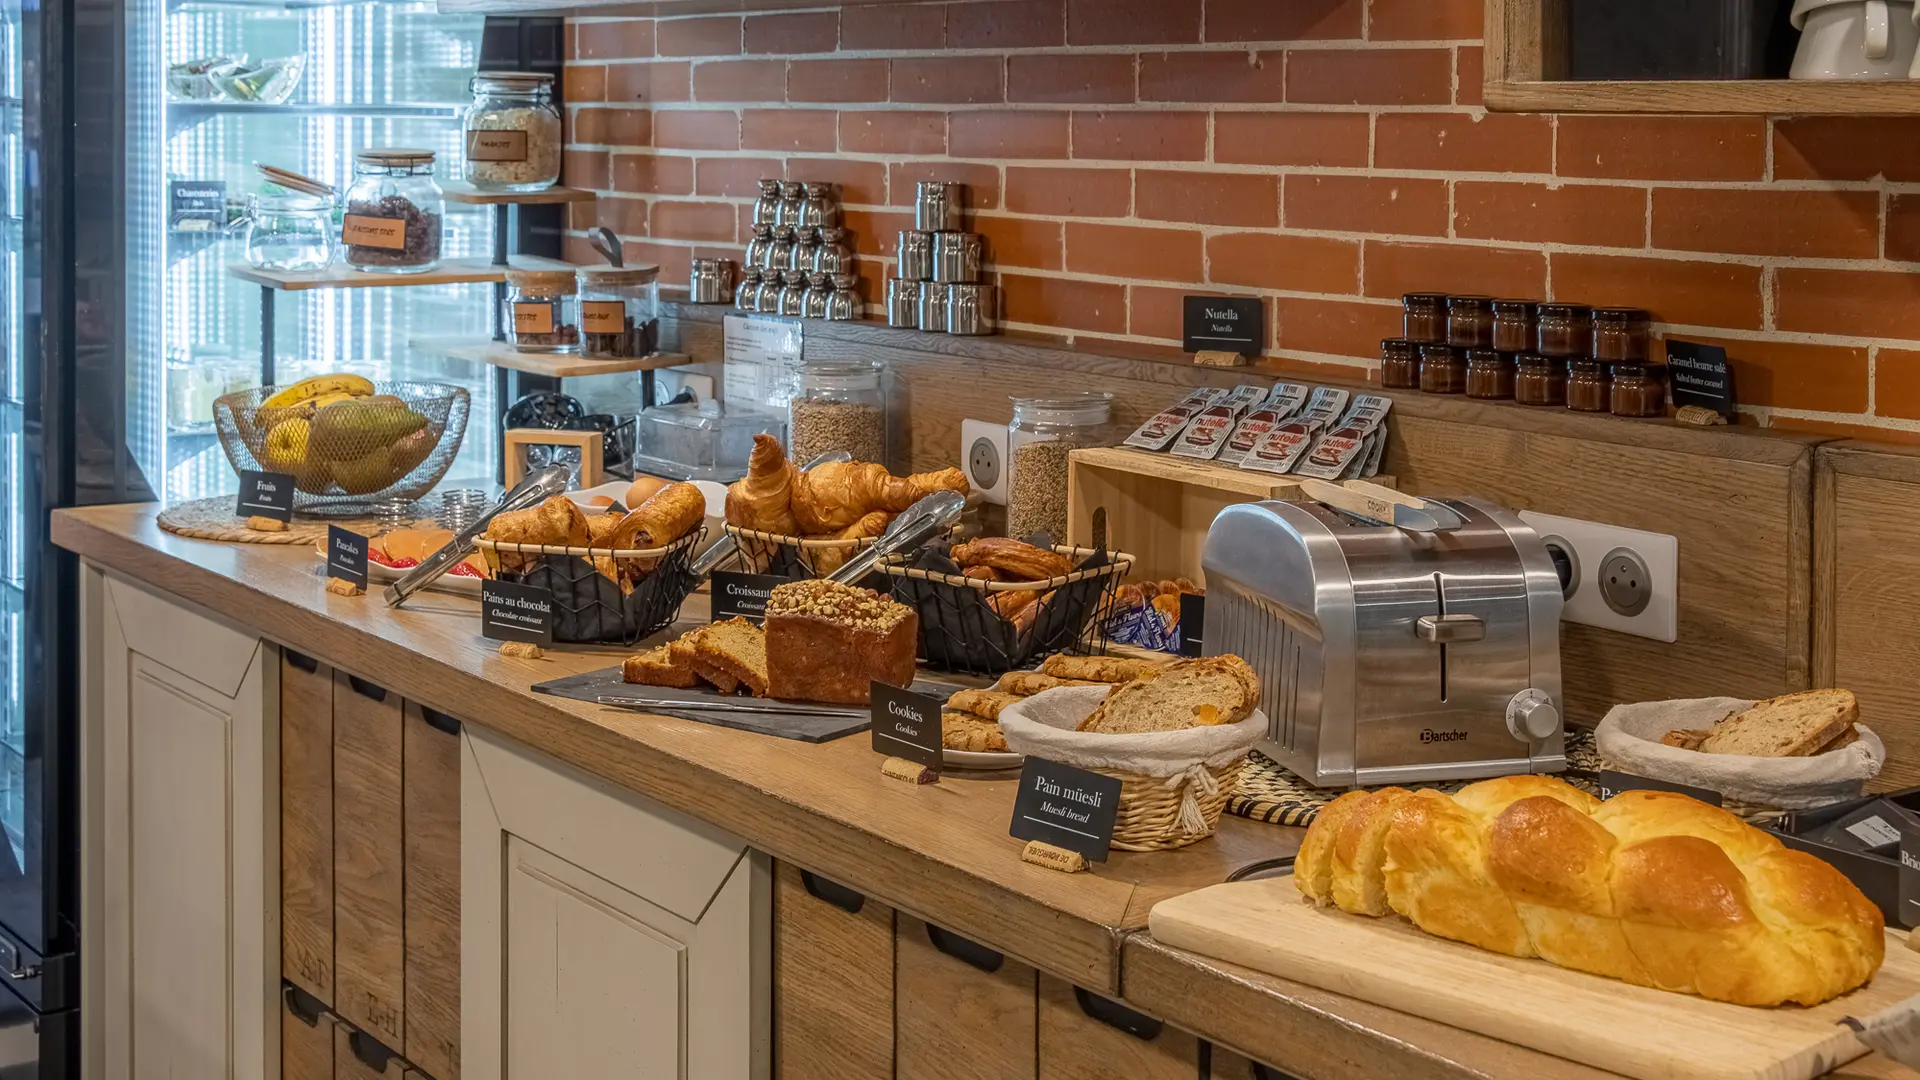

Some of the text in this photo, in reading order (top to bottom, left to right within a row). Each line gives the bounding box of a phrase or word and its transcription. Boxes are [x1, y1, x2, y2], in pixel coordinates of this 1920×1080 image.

[1205, 308, 1238, 320] Nutella
[1211, 324, 1233, 333] Nutella
[1668, 354, 1727, 374] Caramel beurre salé
[1676, 373, 1724, 389] Salted butter caramel
[1153, 415, 1181, 425] nutella
[1195, 417, 1229, 428] nutella
[1240, 422, 1271, 433] nutella
[1267, 433, 1304, 445] nutella
[1322, 439, 1356, 450] nutella
[257, 480, 276, 491] Fruits
[336, 537, 359, 555] Pancakes
[483, 590, 551, 613] Pains au chocolat
[492, 608, 543, 625] Chocolate croissant
[888, 701, 923, 722] Cookies
[895, 722, 917, 736] Cookies
[1420, 728, 1468, 744] Bartscher
[1035, 775, 1103, 808] Pain müesli
[1040, 801, 1090, 824] Muesli bread
[1060, 855, 1070, 864] DE
